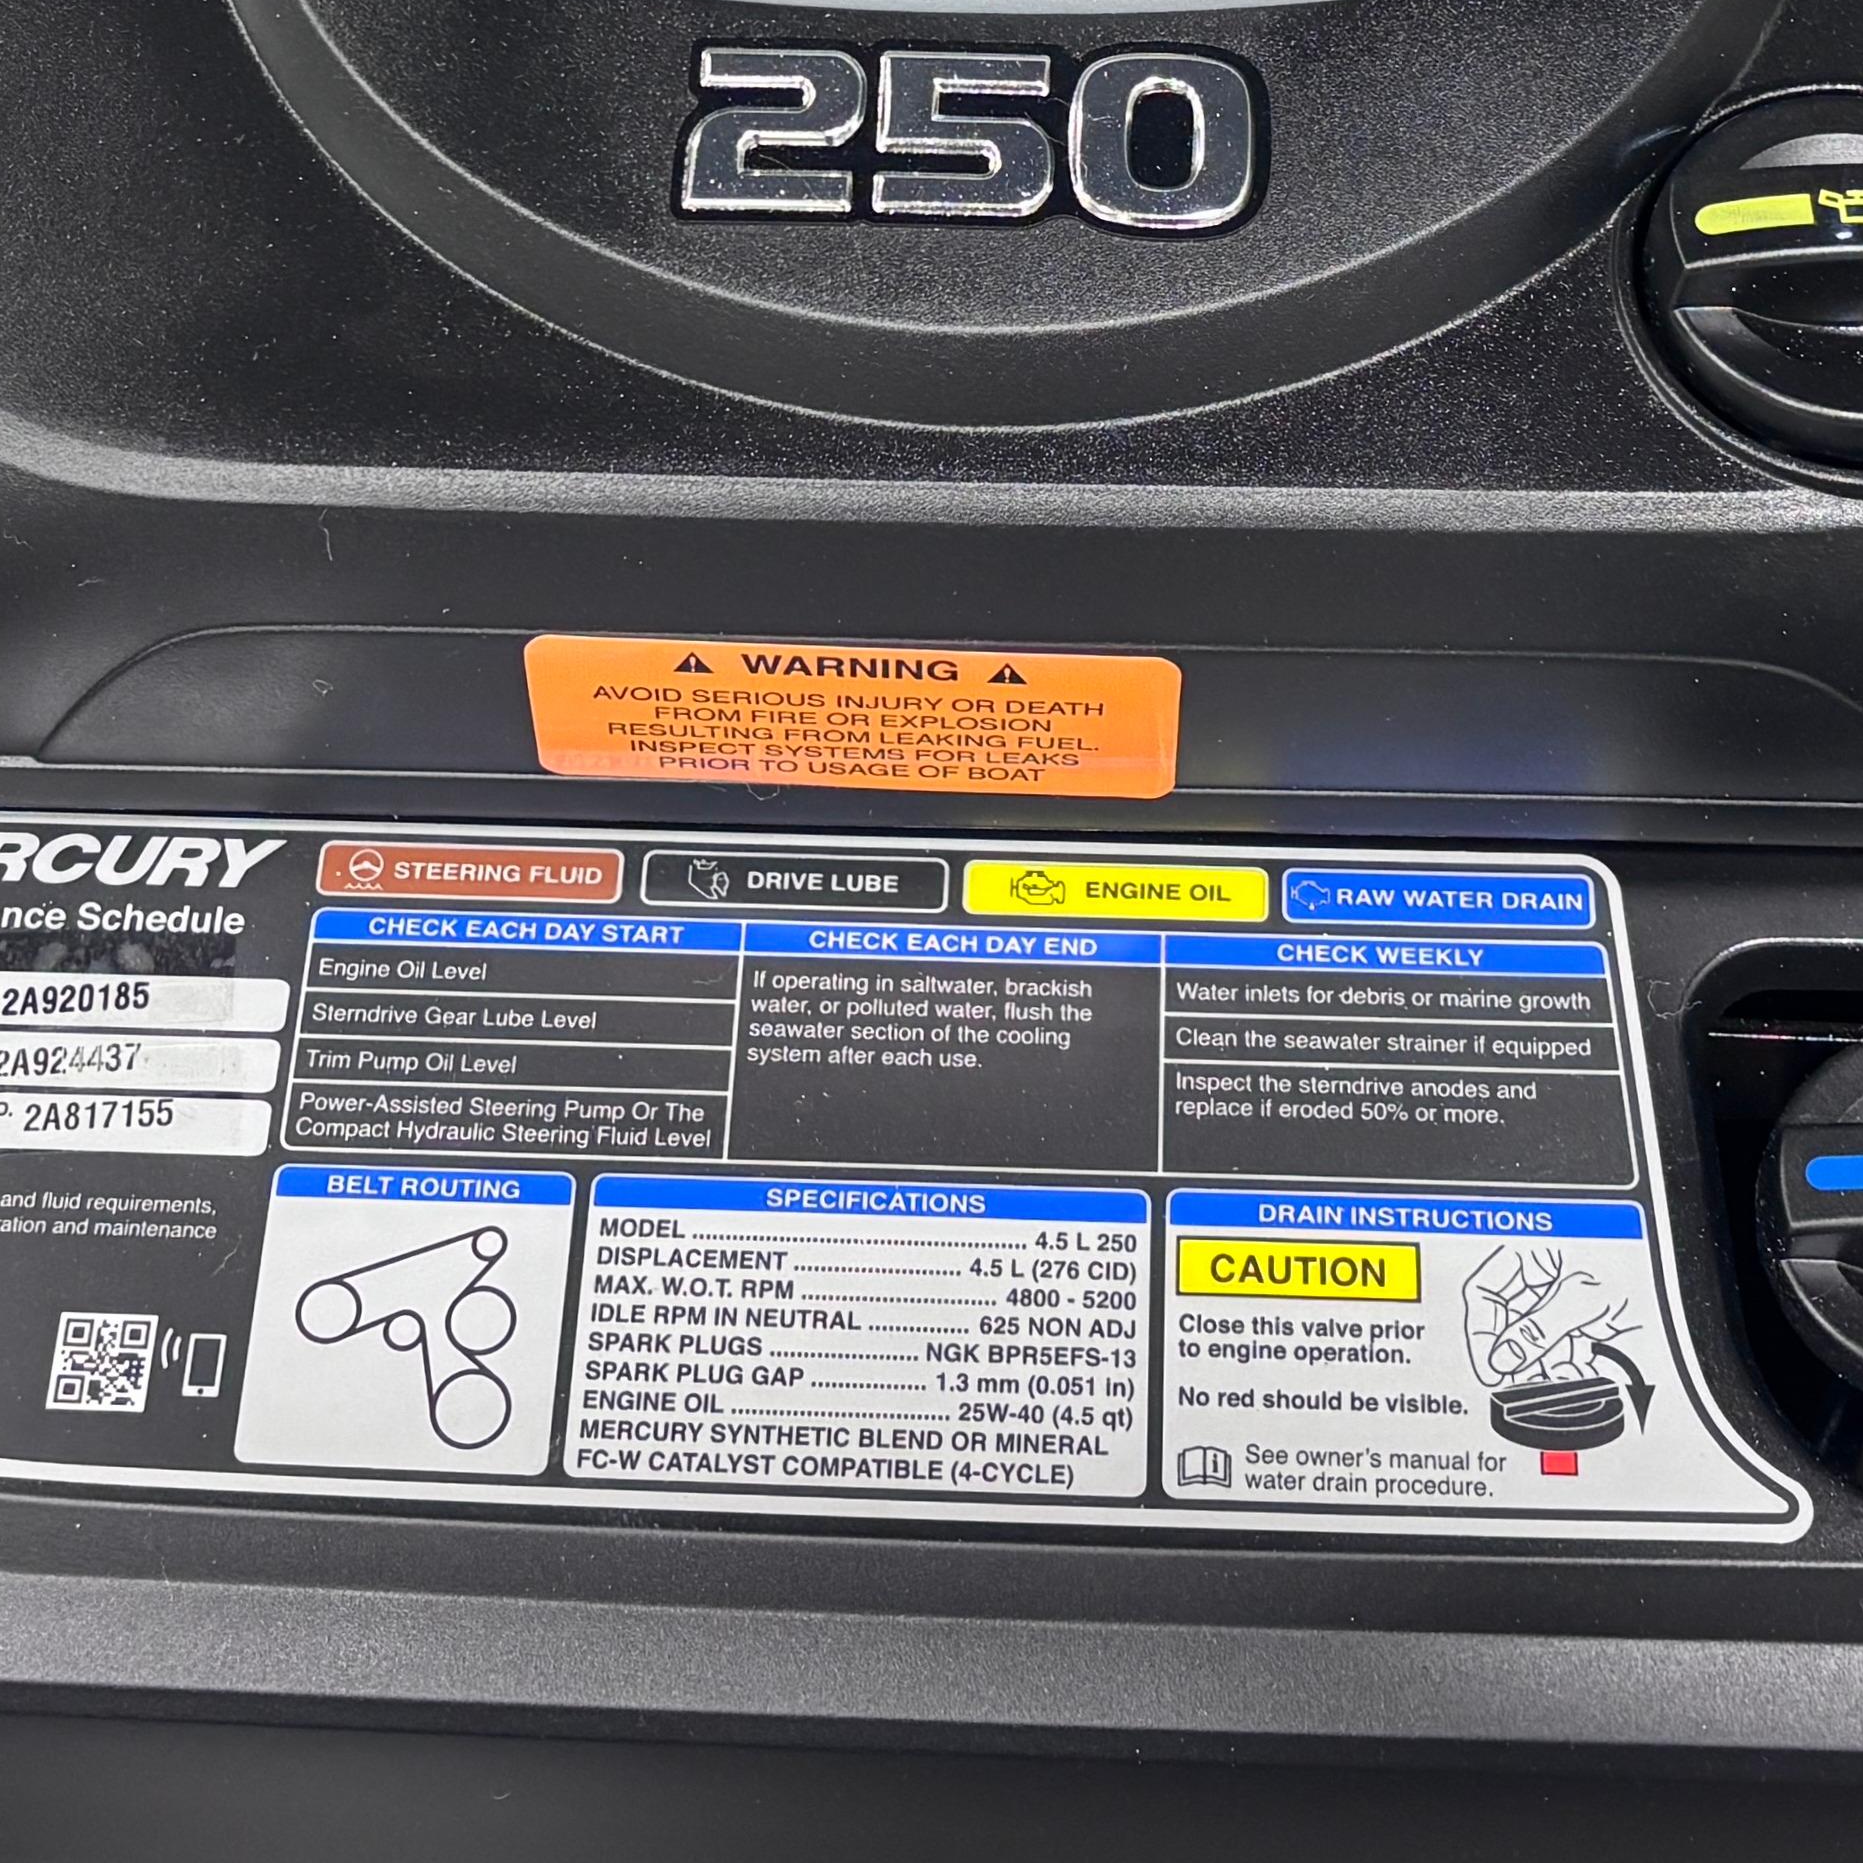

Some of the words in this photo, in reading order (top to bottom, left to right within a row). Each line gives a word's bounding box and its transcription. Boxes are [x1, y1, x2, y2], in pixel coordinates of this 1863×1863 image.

[681, 47, 1253, 230] 250
[741, 653, 958, 681] WARNING
[593, 685, 682, 702] AVOID
[692, 689, 825, 707] SERIOUS
[837, 695, 942, 710] INJURY
[951, 698, 994, 713] OR
[1006, 700, 1103, 716] DEATH
[655, 706, 740, 722] FROM
[751, 709, 816, 724] FIRE
[826, 712, 869, 726] OR
[880, 714, 1051, 732] EXPLOSION
[608, 722, 773, 740] RESULTING
[784, 728, 869, 743] FROM
[880, 732, 1006, 747] LEAKING
[1018, 736, 1098, 751] FUEL.
[630, 740, 755, 755] INSPECT
[765, 744, 904, 760] SYSTEMS
[915, 749, 975, 762] FOR
[986, 751, 1079, 766] LEAKS
[659, 756, 749, 771] PRIOR
[758, 759, 798, 772] TO
[808, 761, 909, 777] USAGE
[918, 764, 959, 778] OF
[968, 766, 1045, 781] BOAT
[394, 861, 520, 882] STEERING
[529, 865, 602, 884] FLUID
[747, 871, 823, 890] DRIVE
[831, 874, 898, 893] LUBE
[1086, 881, 1181, 900] ENGINE
[1189, 884, 1231, 901] OIL
[1336, 888, 1394, 906] RAW
[1403, 890, 1492, 908] WATER
[1502, 892, 1582, 910] DRAIN
[77, 901, 245, 934] Schedule
[369, 916, 457, 937] CHECK
[466, 919, 536, 939] EACH
[544, 922, 595, 941] DAY
[602, 923, 684, 943] START
[809, 930, 897, 950] CHECK
[907, 933, 977, 952] EACH
[986, 935, 1036, 954] DAY
[1044, 936, 1097, 956] END
[1277, 943, 1367, 963] CHECK
[1375, 946, 1483, 966] WEEKLY
[318, 957, 390, 981] Engine
[396, 959, 425, 978] Oil
[431, 961, 487, 980] Level
[753, 970, 766, 988] If
[772, 972, 868, 995] operating
[876, 974, 893, 991] in
[900, 972, 997, 996] saltwater,
[1005, 977, 1092, 997] brackish
[2, 982, 150, 1016] 2A920185
[751, 996, 811, 1015] water,
[819, 1000, 840, 1014] or
[846, 998, 928, 1019] polluted
[934, 1002, 996, 1021] water,
[1004, 1001, 1053, 1020] flush
[1060, 1003, 1092, 1022] the
[1176, 982, 1238, 1001] Water
[1245, 984, 1300, 1003] inlets
[1307, 985, 1334, 1003] for
[1341, 986, 1404, 1006] debris
[1411, 992, 1433, 1006] or
[1439, 987, 1512, 1008] marine
[1518, 992, 1590, 1013] growth
[312, 1002, 417, 1024] Sterndrive
[424, 1006, 476, 1025] Gear
[482, 1008, 534, 1027] Lube
[541, 1009, 596, 1029] Level
[306, 1049, 351, 1068] Trim
[358, 1050, 418, 1074] Pump
[425, 1052, 454, 1071] Oil
[460, 1054, 517, 1073] Level
[1176, 1071, 1252, 1095] Inspect
[1259, 1074, 1291, 1092] the
[1299, 1076, 1403, 1095] sterndrive
[1411, 1079, 1490, 1098] anodes
[1496, 1081, 1536, 1099] and
[24, 1099, 174, 1132] 2A817155
[299, 1091, 462, 1115] Power-Assisted
[469, 1096, 556, 1122] Steering
[564, 1099, 625, 1123] Pump
[631, 1101, 658, 1120] Or
[665, 1102, 704, 1122] The
[327, 1174, 394, 1195] BELT
[401, 1177, 520, 1199] ROUTING
[0, 1191, 36, 1208] and
[42, 1191, 81, 1209] fluid
[86, 1194, 216, 1215] requirements,
[766, 1188, 985, 1213] SPECIFICATIONS
[599, 1217, 685, 1238] MODEL
[1259, 1204, 1344, 1224] DRAIN
[1351, 1206, 1552, 1231] INSTRUCTIONS
[597, 1245, 788, 1271] DISPLACEMENT
[1210, 1253, 1385, 1287] CAUTION
[1179, 1313, 1244, 1334] Close
[1251, 1316, 1294, 1336] this
[1301, 1318, 1362, 1338] valve
[1370, 1320, 1426, 1343] prior
[588, 1331, 671, 1353] SPARK
[679, 1334, 762, 1356] PLUGS
[926, 1342, 979, 1363] NGK
[988, 1344, 1136, 1368] BPR5EFS-13
[585, 1360, 669, 1382] SPARK
[676, 1363, 743, 1384] PLUG
[751, 1365, 804, 1387] GAP
[936, 1372, 969, 1392] 1.3
[977, 1377, 1019, 1394] mm
[1028, 1374, 1094, 1399] (0.051
[1106, 1377, 1134, 1402] in)
[1178, 1385, 1210, 1406] No
[1218, 1388, 1254, 1408] red
[1262, 1389, 1341, 1410] should
[1350, 1391, 1379, 1411] be
[1385, 1393, 1468, 1415] visible.
[577, 1448, 641, 1470] FC-W
[648, 1450, 776, 1475] CATALYST
[782, 1455, 943, 1480] COMPATIBLE
[951, 1460, 1074, 1490] (4-CYCLE)
